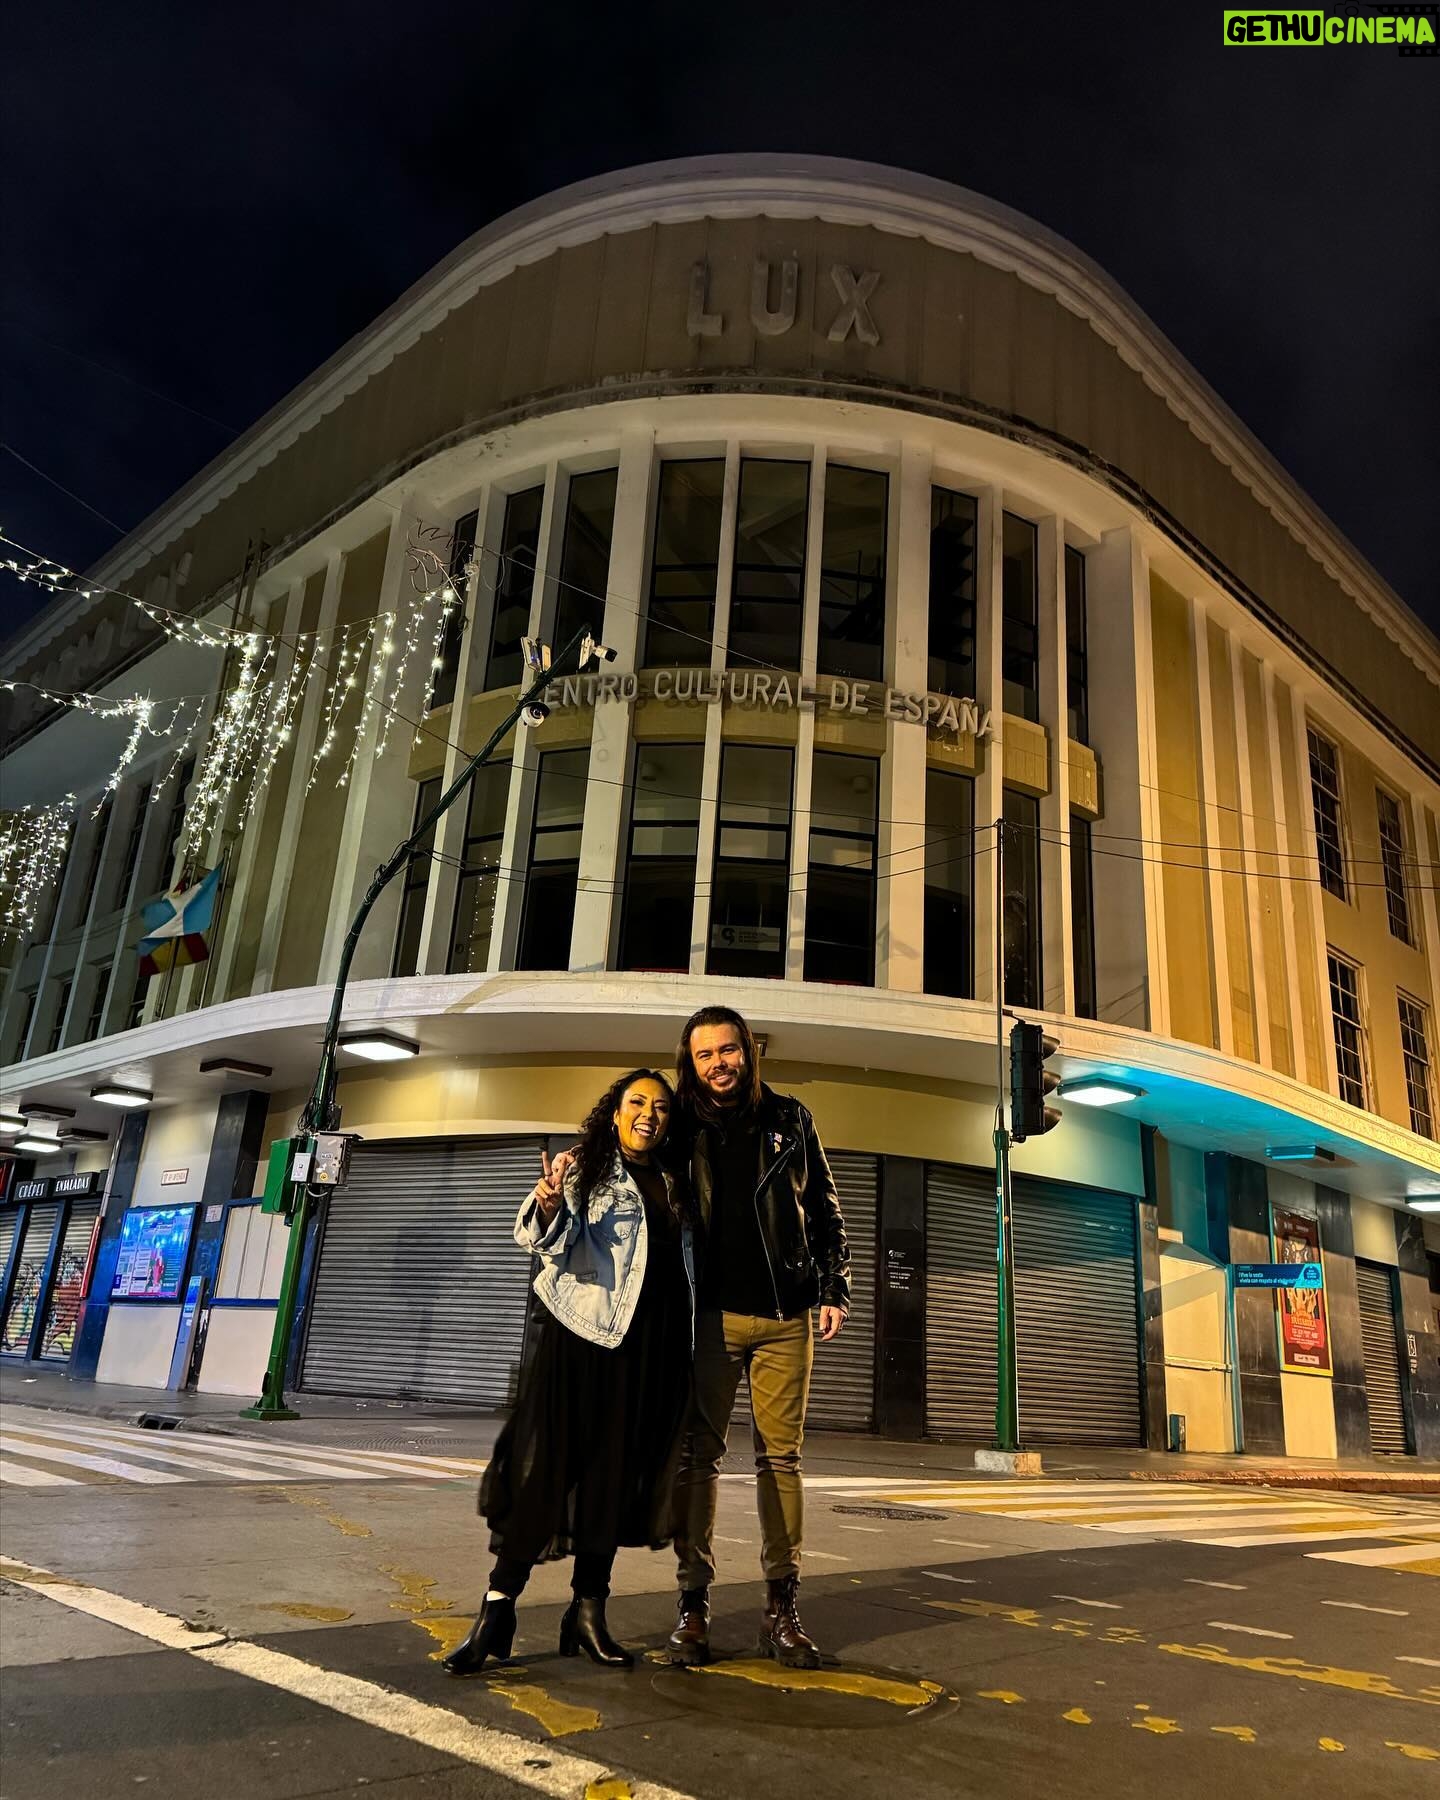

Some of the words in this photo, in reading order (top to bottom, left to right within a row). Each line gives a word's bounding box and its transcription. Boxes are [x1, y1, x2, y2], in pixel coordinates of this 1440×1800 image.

[686, 257, 881, 347] LUX
[538, 671, 639, 709] ENTRO
[653, 670, 815, 709] CULTURAL
[829, 679, 871, 716] DE
[884, 687, 995, 738] ESPAÑA
[55, 1176, 90, 1192] ENSALADAS
